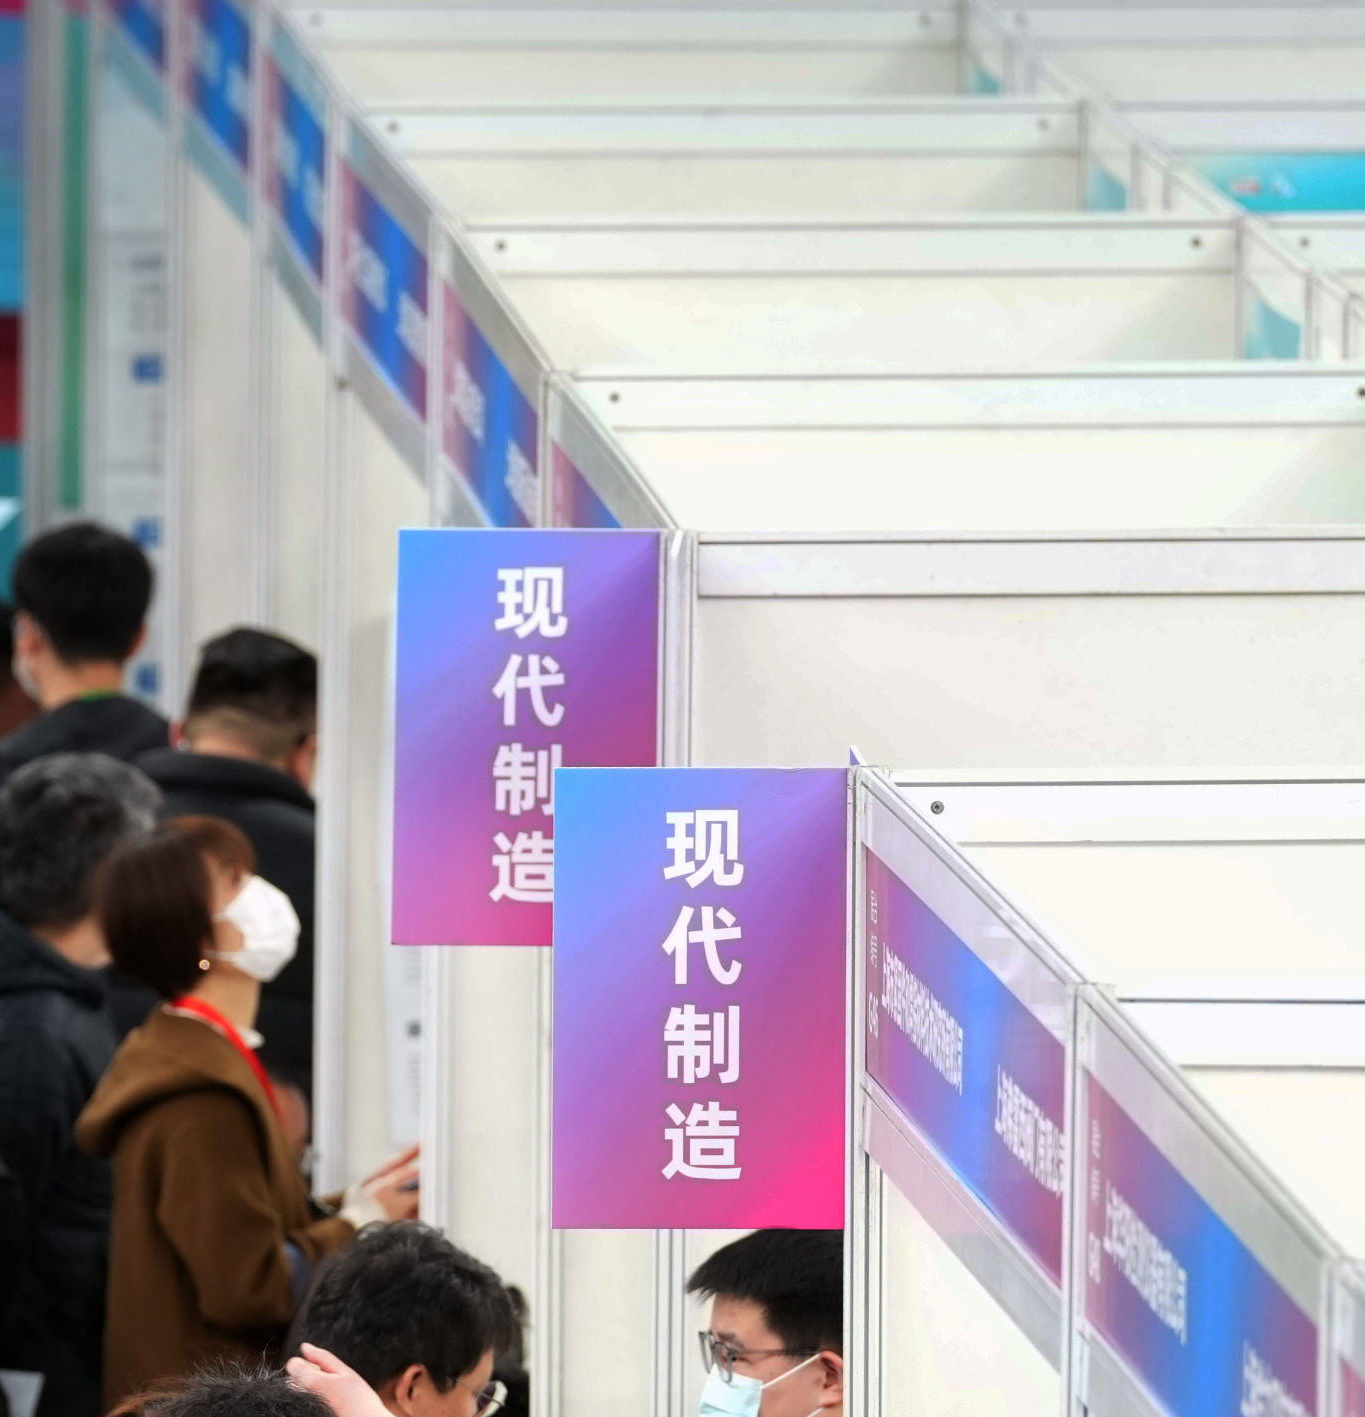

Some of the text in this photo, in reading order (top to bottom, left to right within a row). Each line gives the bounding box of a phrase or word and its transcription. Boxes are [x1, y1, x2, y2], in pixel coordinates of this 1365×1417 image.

[489, 566, 569, 904] 现代制造
[662, 809, 744, 1181] 现代制造
